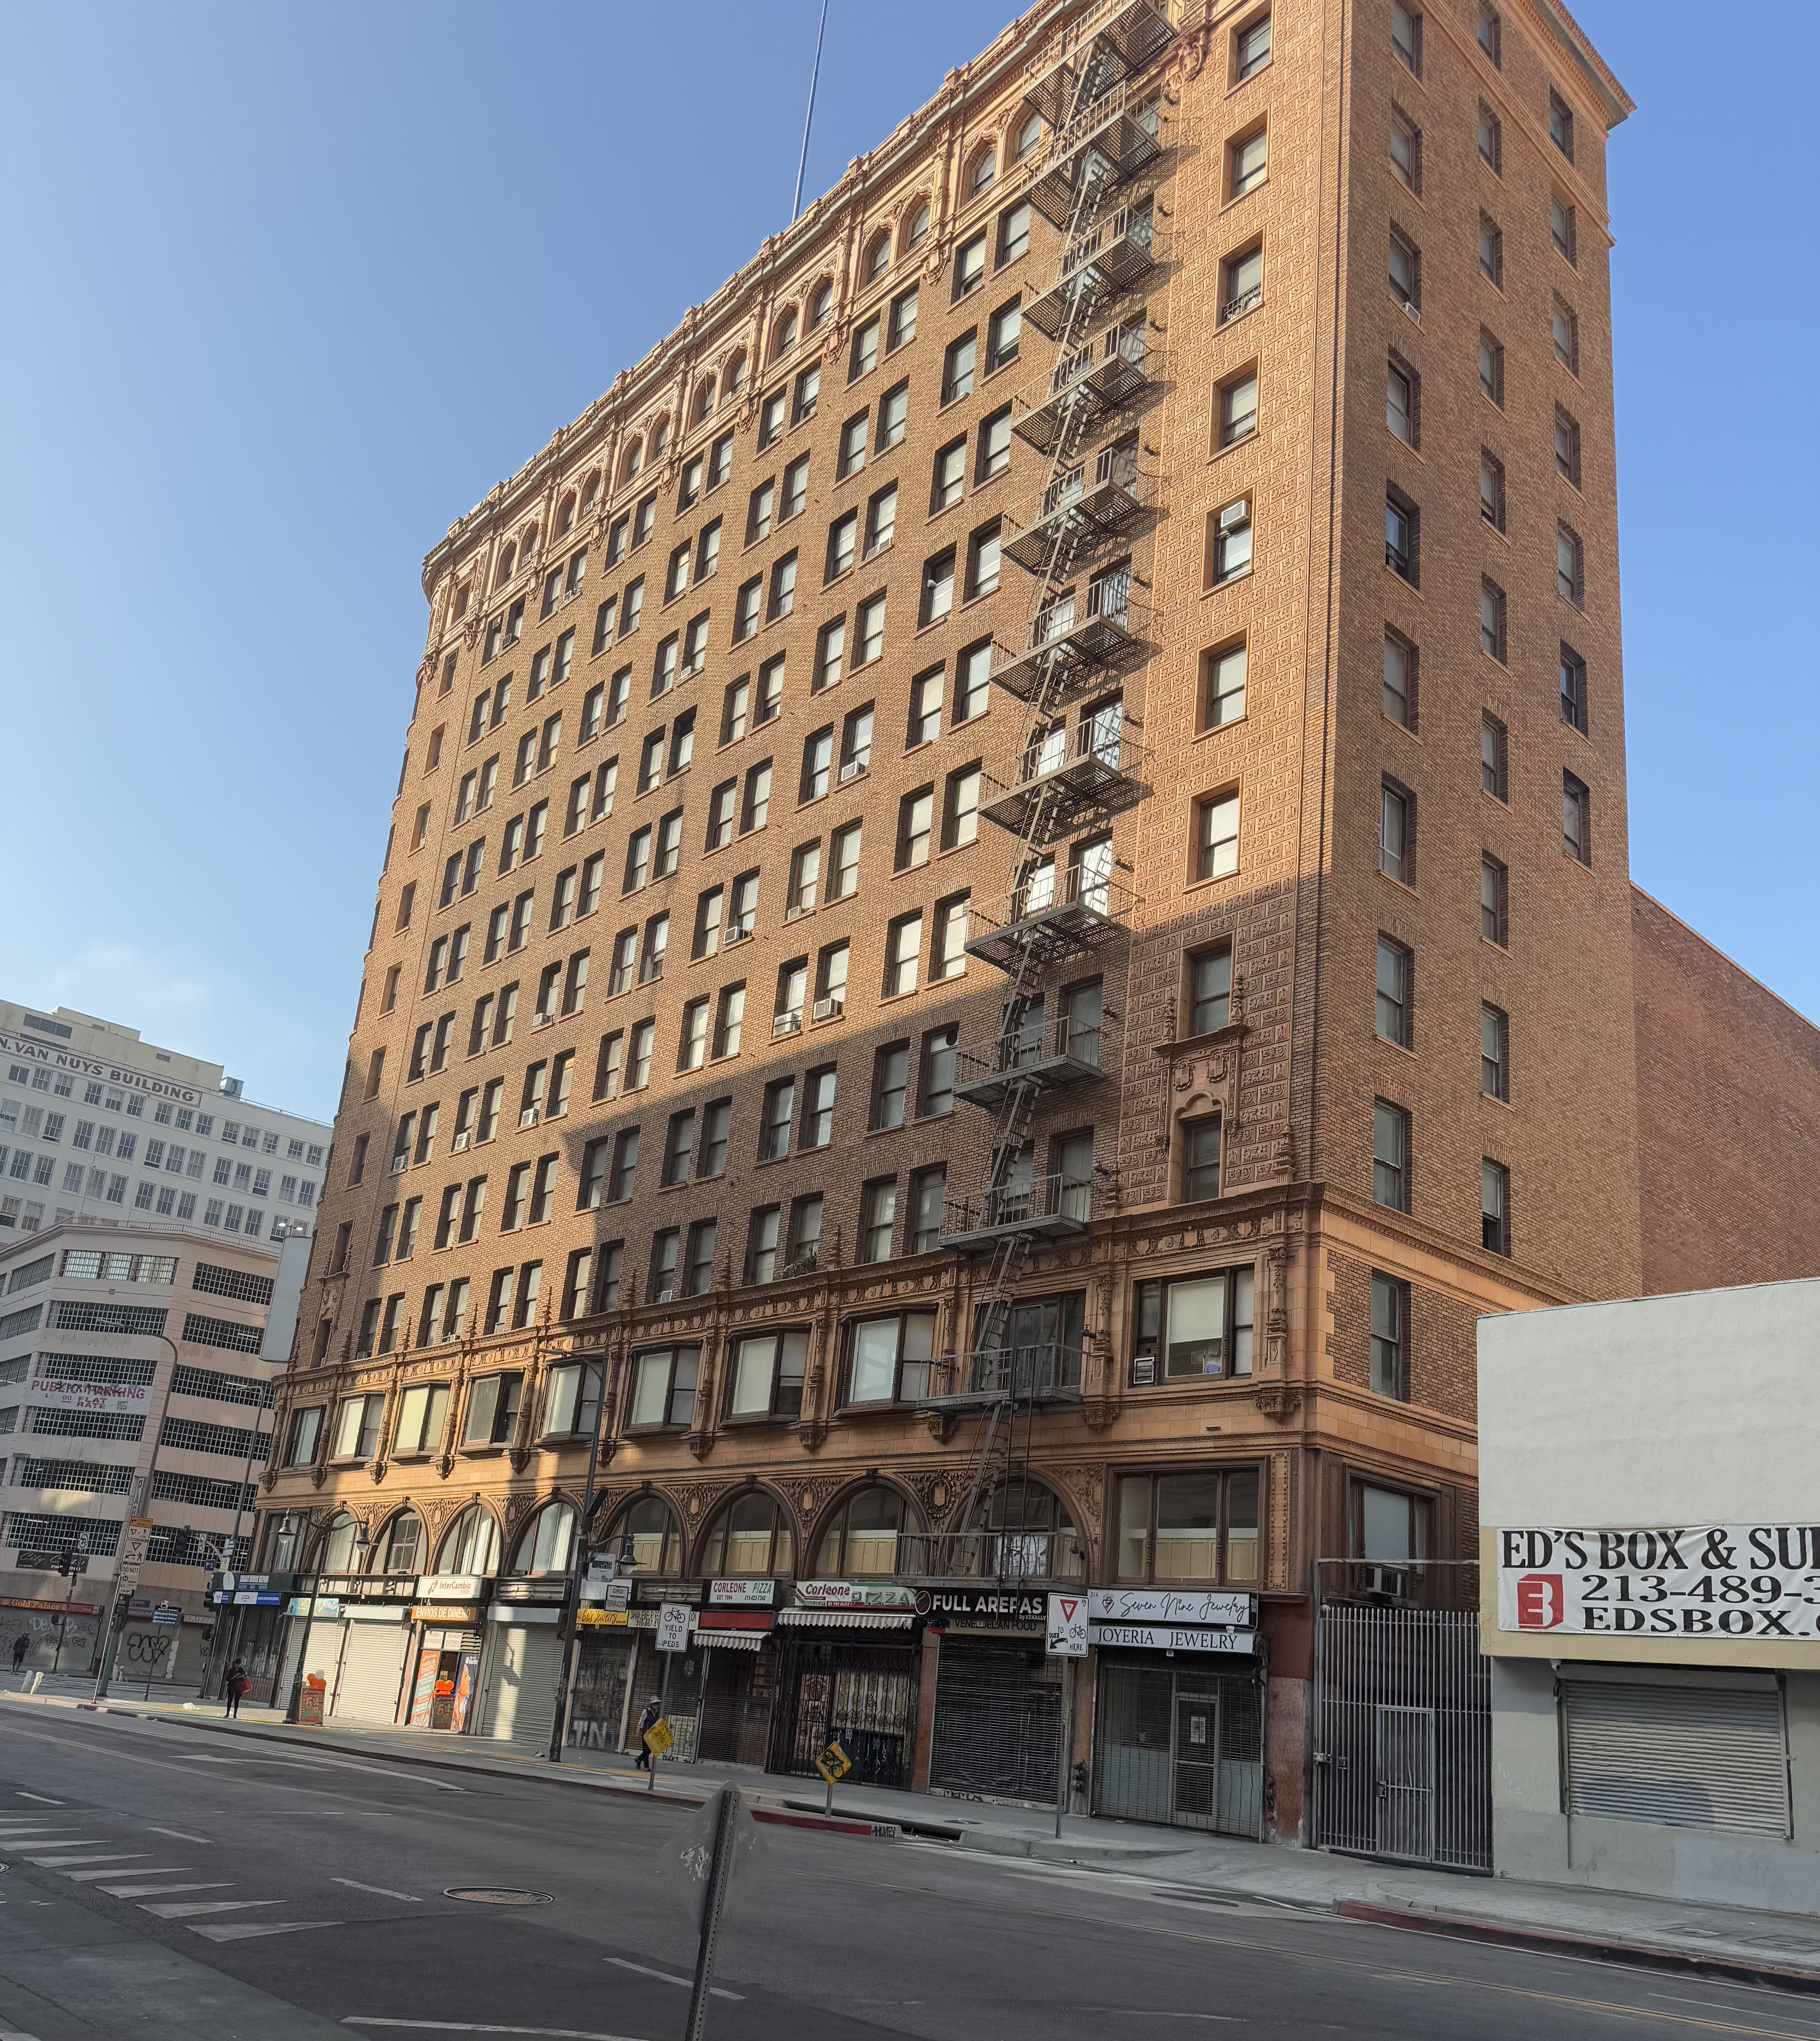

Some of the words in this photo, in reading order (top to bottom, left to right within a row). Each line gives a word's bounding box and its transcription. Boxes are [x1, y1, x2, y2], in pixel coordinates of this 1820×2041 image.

[15, 1042, 49, 1060] VAN
[56, 1054, 103, 1076] NUYS
[110, 1070, 194, 1102] BUILDING
[1502, 1530, 1588, 1569] ED'S
[1599, 1530, 1689, 1569] BOX
[1701, 1528, 1738, 1570] &
[714, 1582, 747, 1593] CORLEONE
[752, 1583, 772, 1594] PIZZA
[805, 1583, 850, 1596] Corleone
[851, 1591, 911, 1607] PIZZA
[12, 1599, 30, 1607] Gold
[33, 1600, 60, 1610] Palace
[415, 1607, 437, 1617] ENVIOS
[438, 1608, 447, 1617] DE
[448, 1608, 471, 1618] DINERO
[933, 1595, 971, 1611] FULL
[975, 1596, 1043, 1614] AREPAS
[1120, 1592, 1157, 1617] Seven
[1160, 1593, 1194, 1619] Nine
[1199, 1594, 1249, 1623] Jewelry
[665, 1624, 682, 1632] YIELD
[1098, 1628, 1155, 1645] JOYERIA
[1169, 1631, 1239, 1649] JEWELRY
